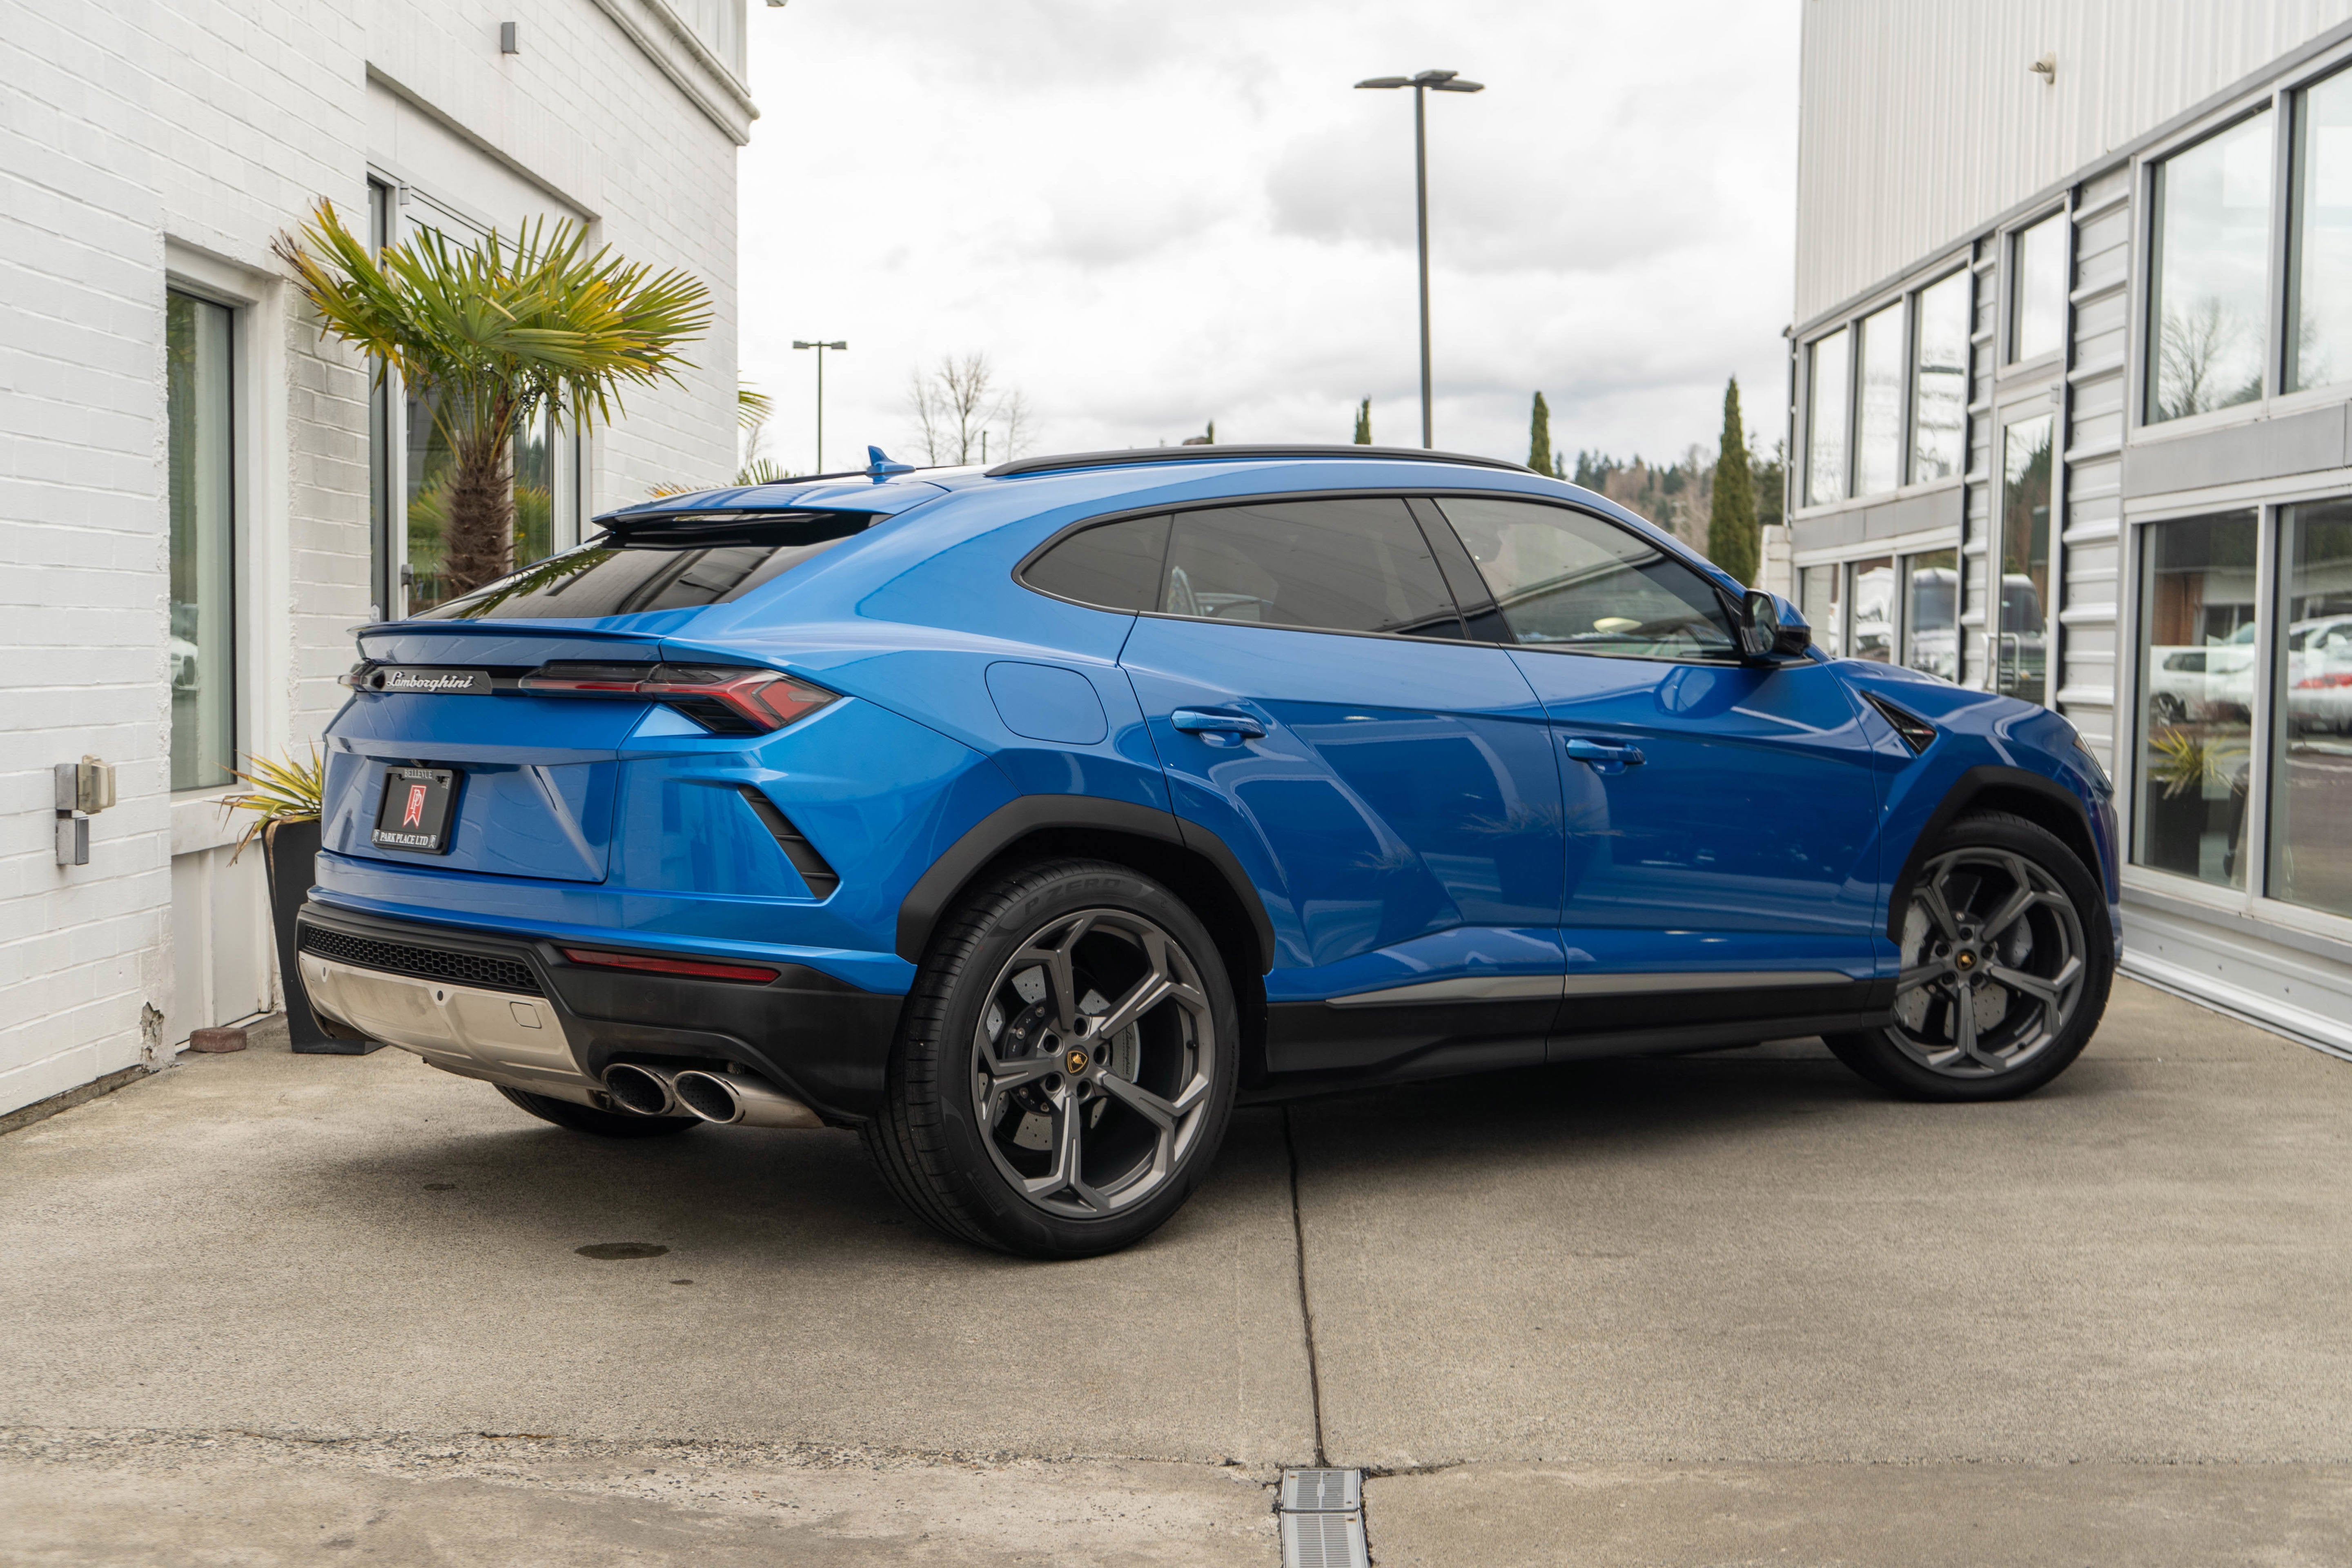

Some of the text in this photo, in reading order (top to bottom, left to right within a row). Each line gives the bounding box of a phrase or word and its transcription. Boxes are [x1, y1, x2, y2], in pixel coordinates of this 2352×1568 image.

[386, 671, 474, 691] Lamborghini
[404, 769, 432, 779] BELLEVUE
[379, 832, 396, 842] PARK
[396, 834, 415, 844] PLACE
[415, 835, 428, 846] LTD
[1047, 878, 1121, 899] ZERO
